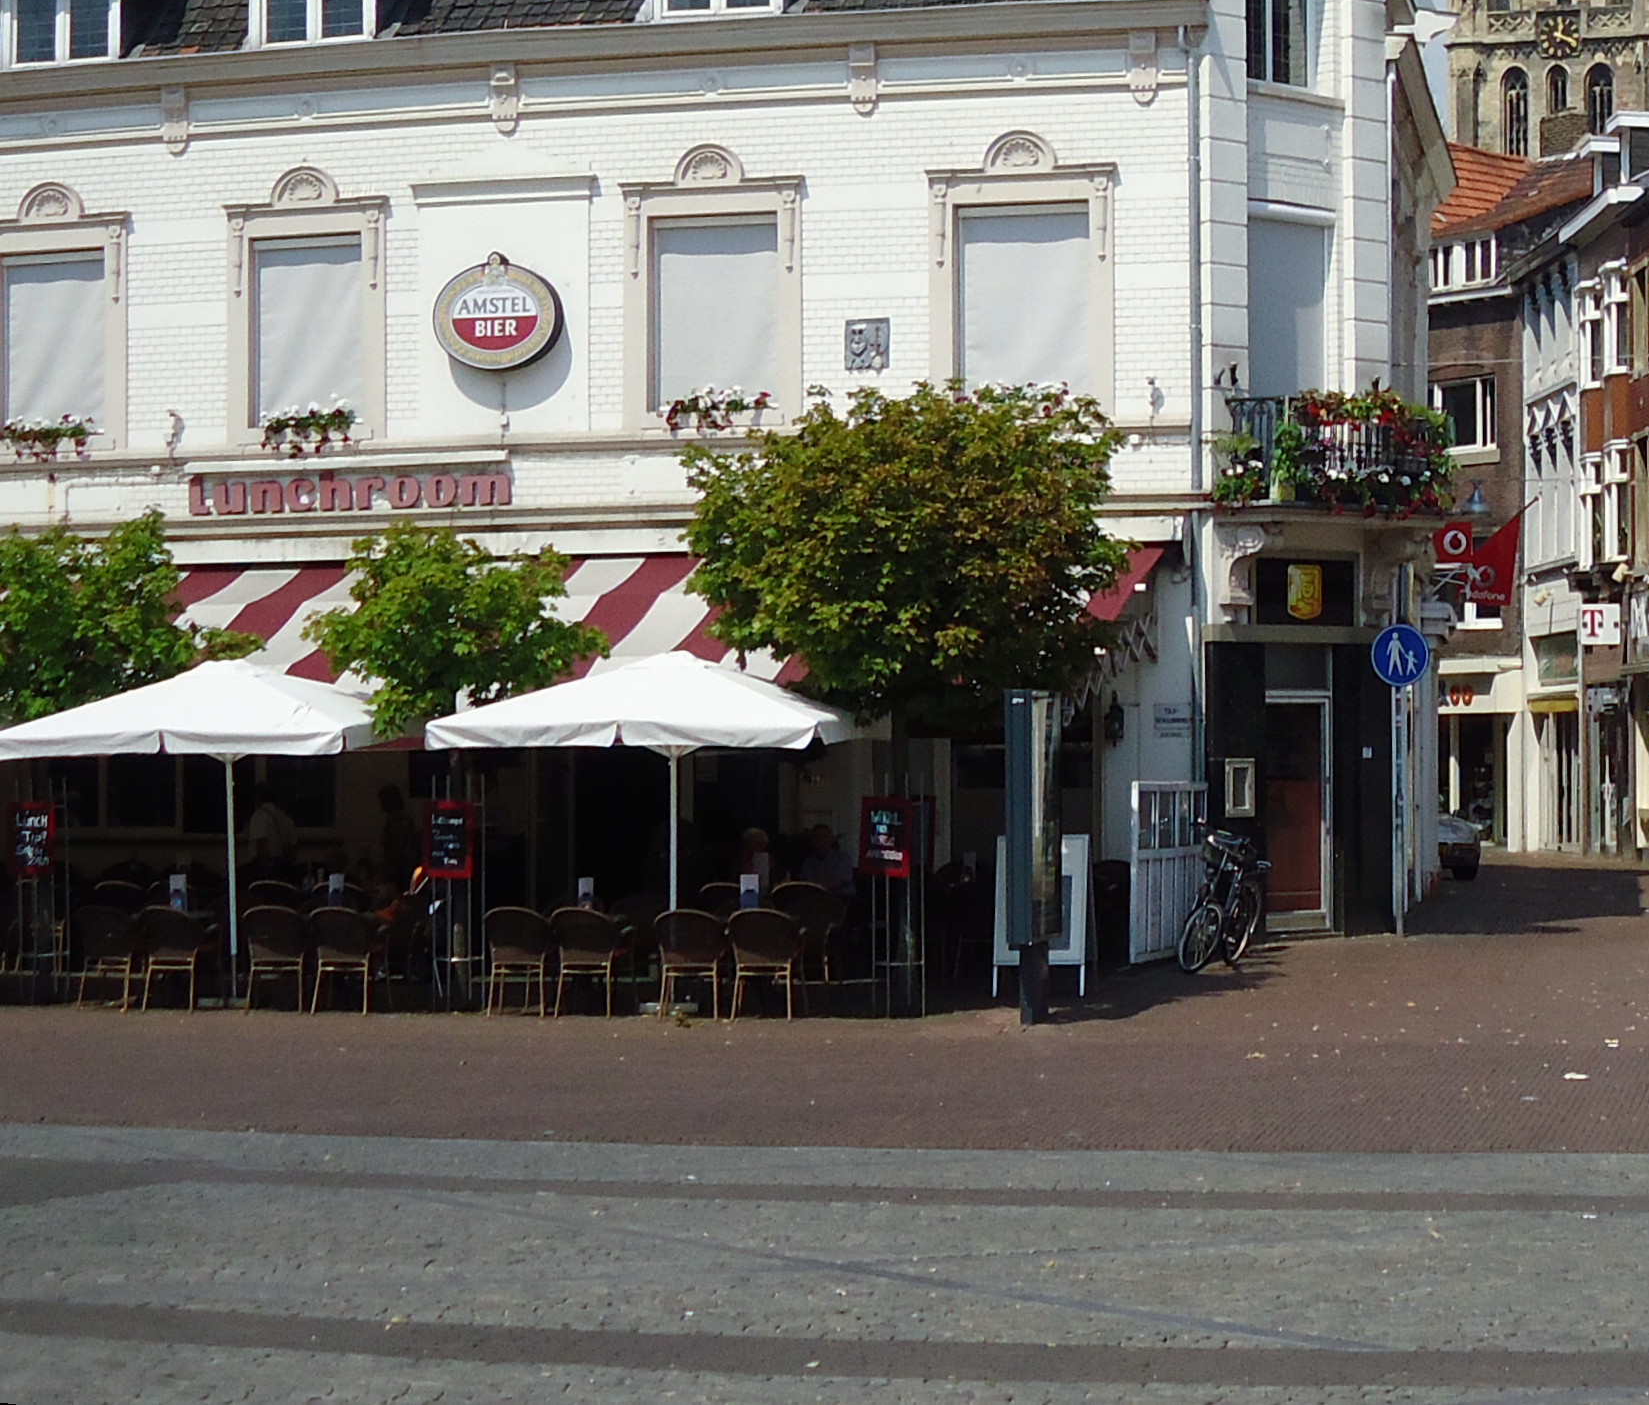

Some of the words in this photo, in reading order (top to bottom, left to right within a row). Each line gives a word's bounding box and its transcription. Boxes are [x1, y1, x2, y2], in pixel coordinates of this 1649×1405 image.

[457, 296, 532, 315] AMSTEL
[474, 319, 518, 337] BIER
[188, 470, 513, 516] Lunchroom
[1582, 610, 1604, 637] T
